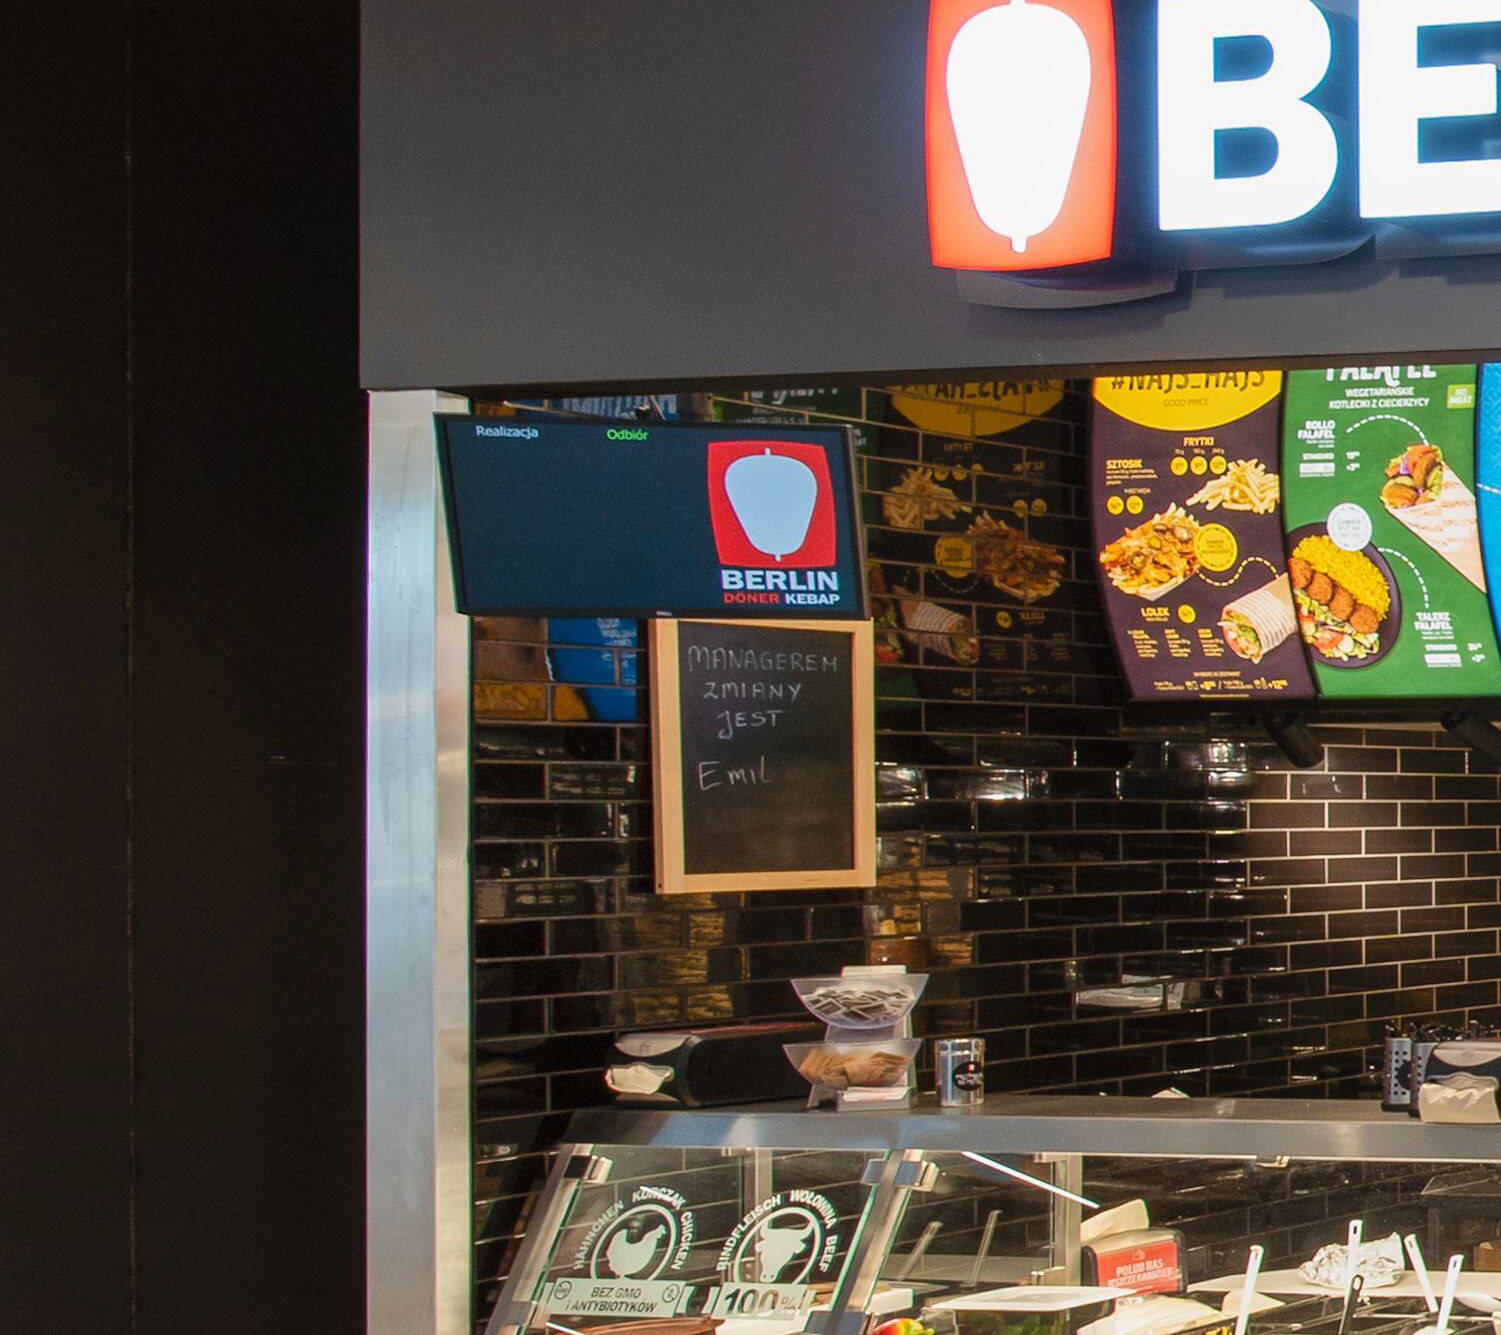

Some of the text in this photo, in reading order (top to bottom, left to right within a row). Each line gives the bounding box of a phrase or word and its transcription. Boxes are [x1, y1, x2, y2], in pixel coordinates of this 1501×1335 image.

[1455, 388, 1468, 396] NO
[1163, 397, 1210, 407] GOOD PRICE
[1449, 396, 1472, 404] MEAT
[1305, 420, 1335, 429] ROLLO
[475, 425, 539, 439] Realizacja
[607, 429, 649, 441] Odbiór
[1298, 430, 1335, 439] FALAFEL
[1183, 437, 1214, 447] FRYTKI
[1106, 459, 1143, 469] SZTOSIK
[721, 569, 840, 591] BERLIN
[723, 593, 840, 605] DÖNER KEBAP
[1140, 607, 1170, 617] LOLEK
[1414, 621, 1453, 630] FALAFEL
[688, 645, 838, 672] MANAGEREM
[703, 681, 802, 702] ZMIANY
[717, 710, 786, 740] JEST
[790, 1189, 838, 1230] WOŁOWINA
[716, 1193, 781, 1271] RINDFLEISCH
[674, 1211, 693, 1271] CHICKEN
[819, 1234, 838, 1273] BEEF
[590, 1286, 641, 1299] BEZ GMO
[571, 1298, 659, 1313] ANTYBIOTYKÓW
